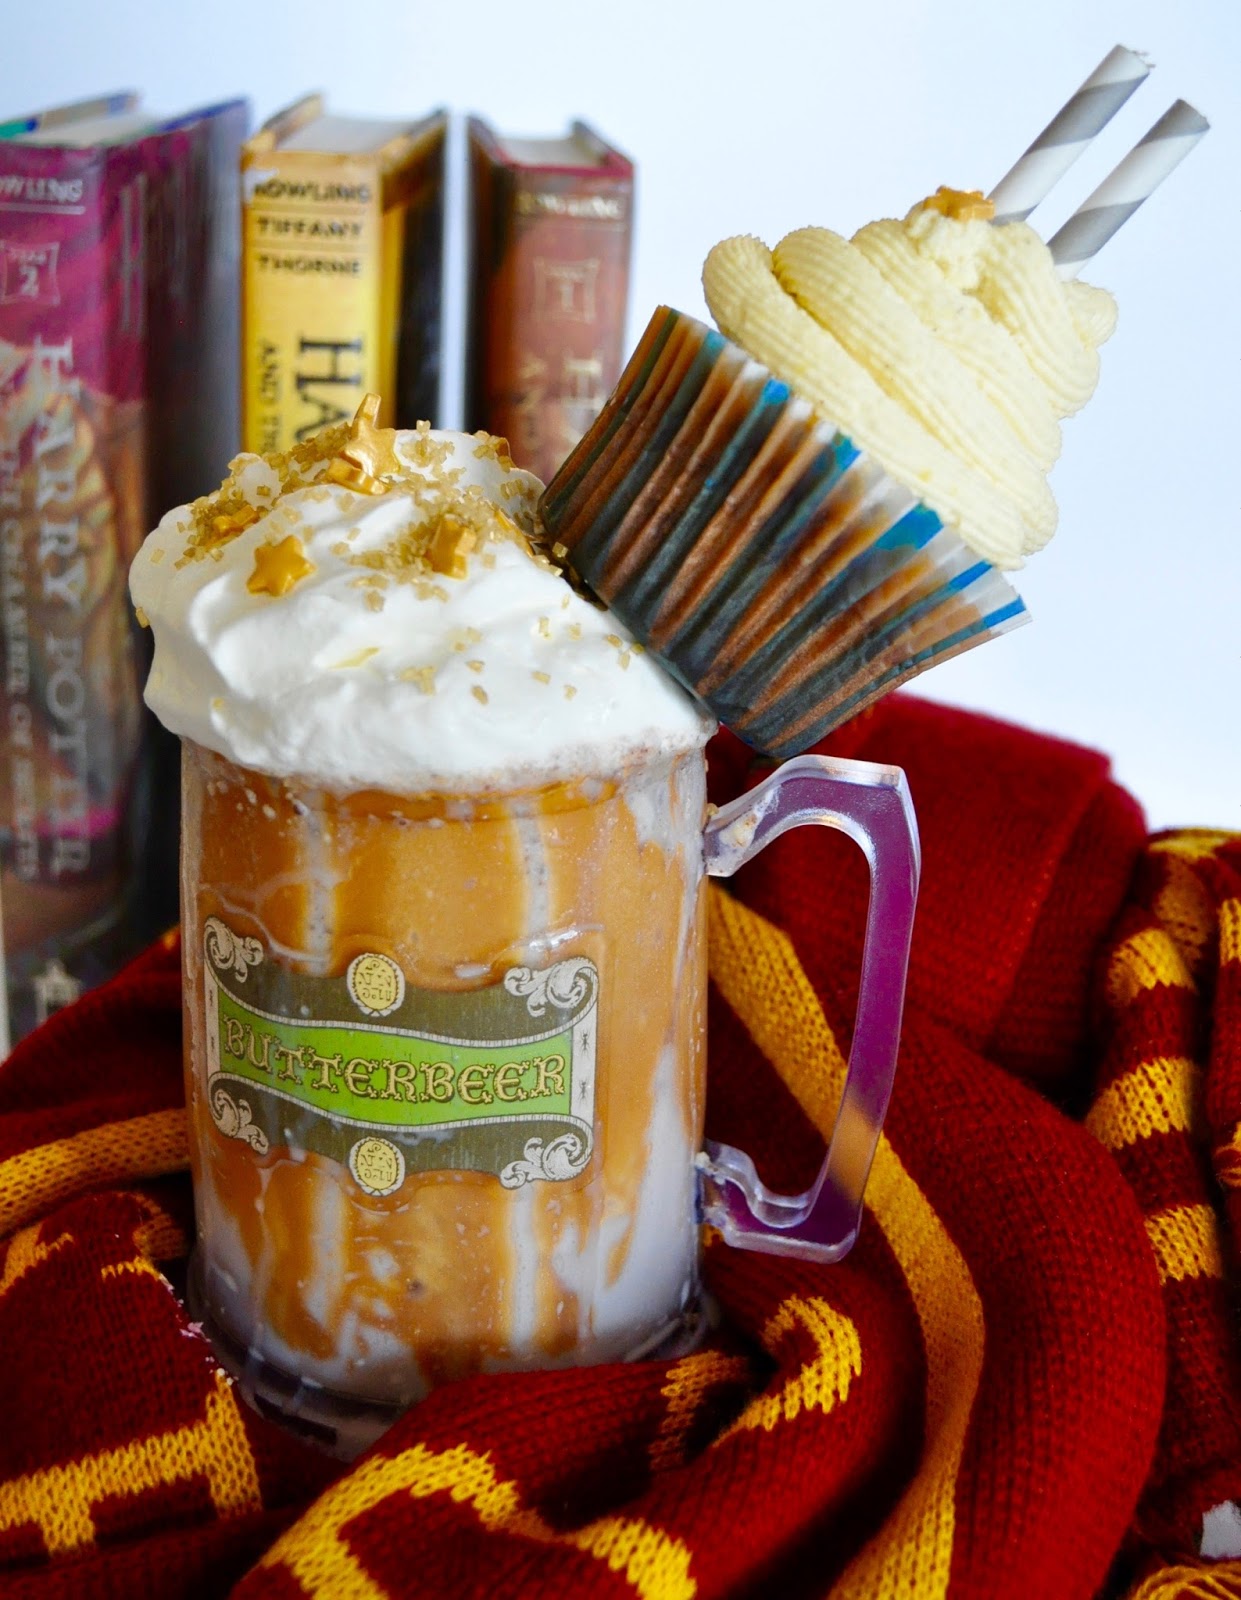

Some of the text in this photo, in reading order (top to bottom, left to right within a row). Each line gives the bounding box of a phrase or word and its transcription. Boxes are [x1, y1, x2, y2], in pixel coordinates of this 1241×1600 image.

[257, 215, 362, 237] TIFFANY
[33, 335, 88, 609] HARRY
[222, 1013, 566, 1105] BUTTERBEER
